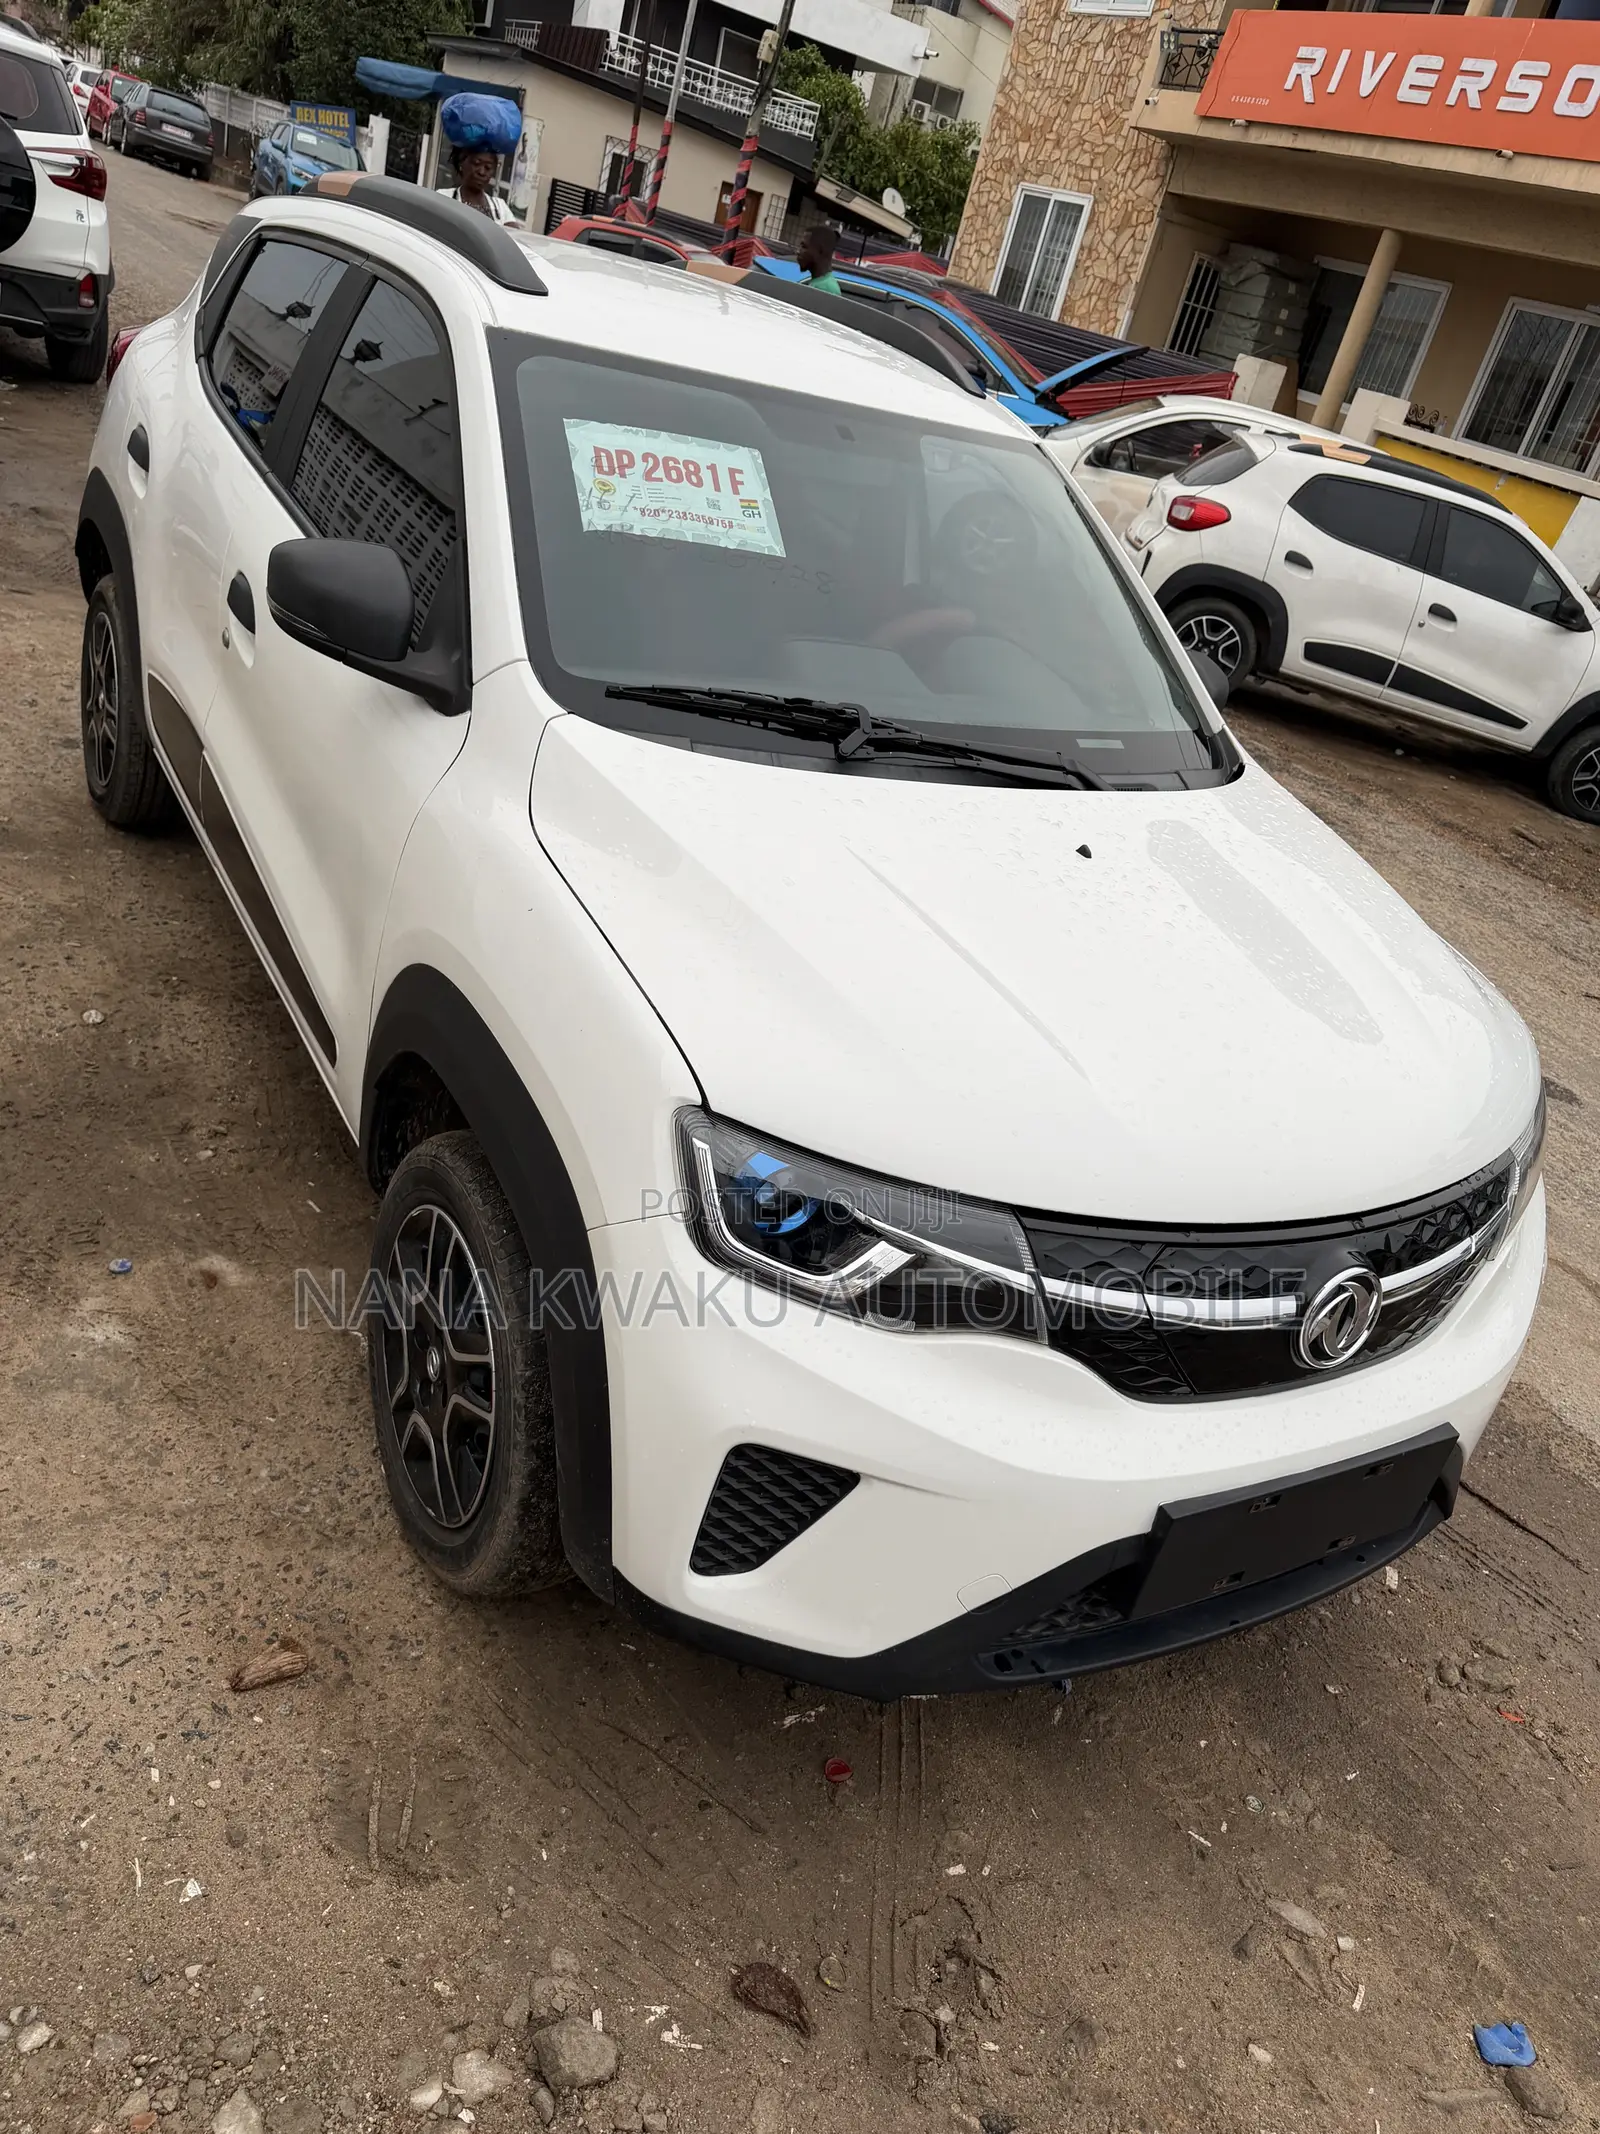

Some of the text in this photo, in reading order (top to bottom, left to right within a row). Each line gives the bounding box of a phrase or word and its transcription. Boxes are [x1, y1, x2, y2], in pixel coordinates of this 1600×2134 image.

[1284, 46, 1600, 118] RIVERSO
[296, 107, 316, 123] REX
[318, 110, 350, 127] HOTEL
[593, 446, 636, 479] DP
[641, 452, 722, 492] 2681
[728, 467, 745, 495] F
[742, 509, 762, 519] GH
